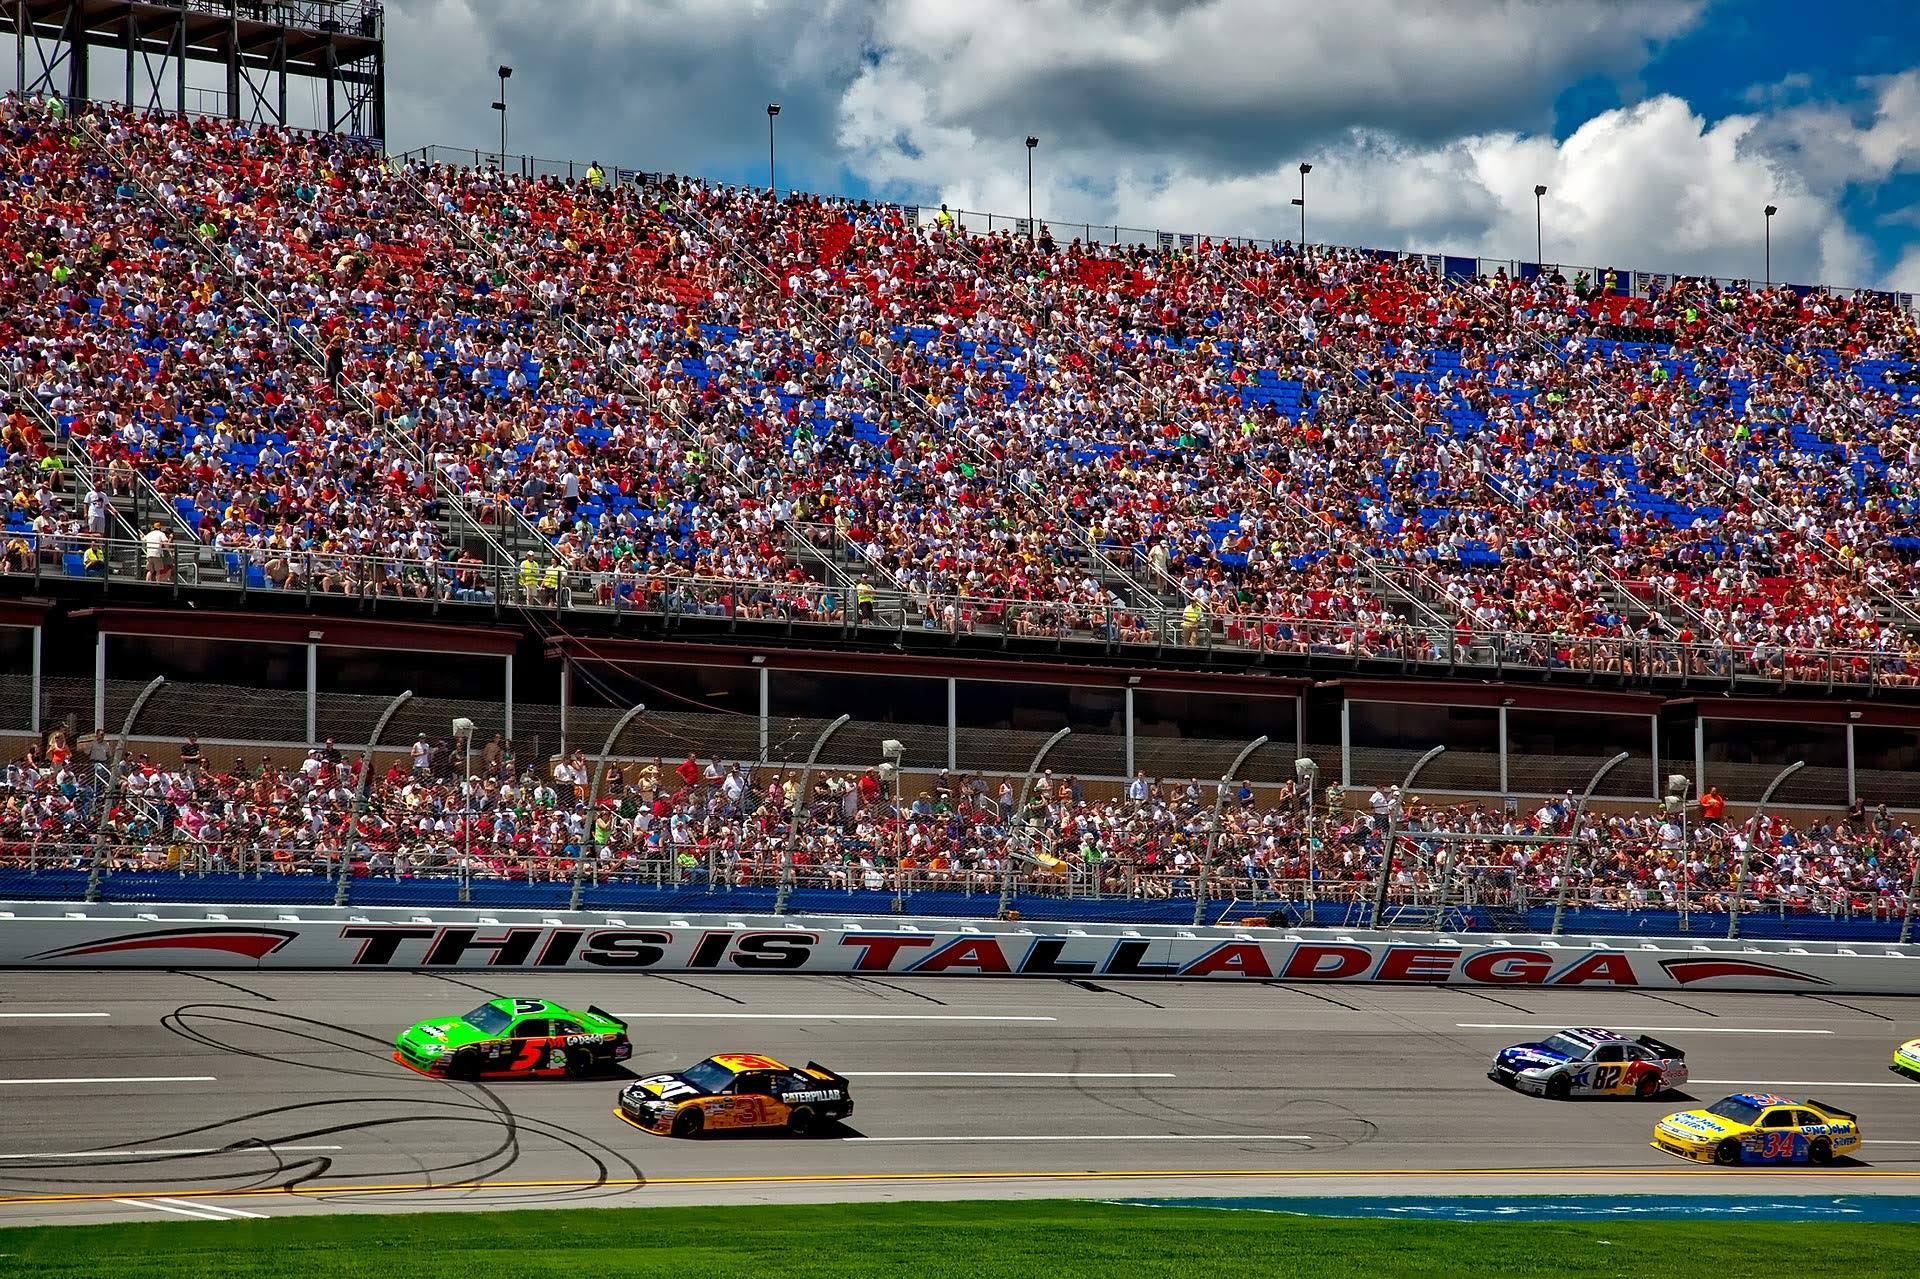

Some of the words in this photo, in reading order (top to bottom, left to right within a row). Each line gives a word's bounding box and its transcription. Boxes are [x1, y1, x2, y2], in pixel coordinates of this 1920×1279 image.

[340, 925, 673, 968] THIS
[686, 930, 819, 969] IS
[840, 933, 1639, 986] TALLADEGA
[509, 1039, 547, 1070] 5
[1592, 1066, 1622, 1090] 82
[781, 1089, 841, 1104] CATERPILLAR
[733, 1095, 769, 1125] 31
[1801, 1126, 1826, 1136] LONG
[1763, 1132, 1794, 1158] 34
